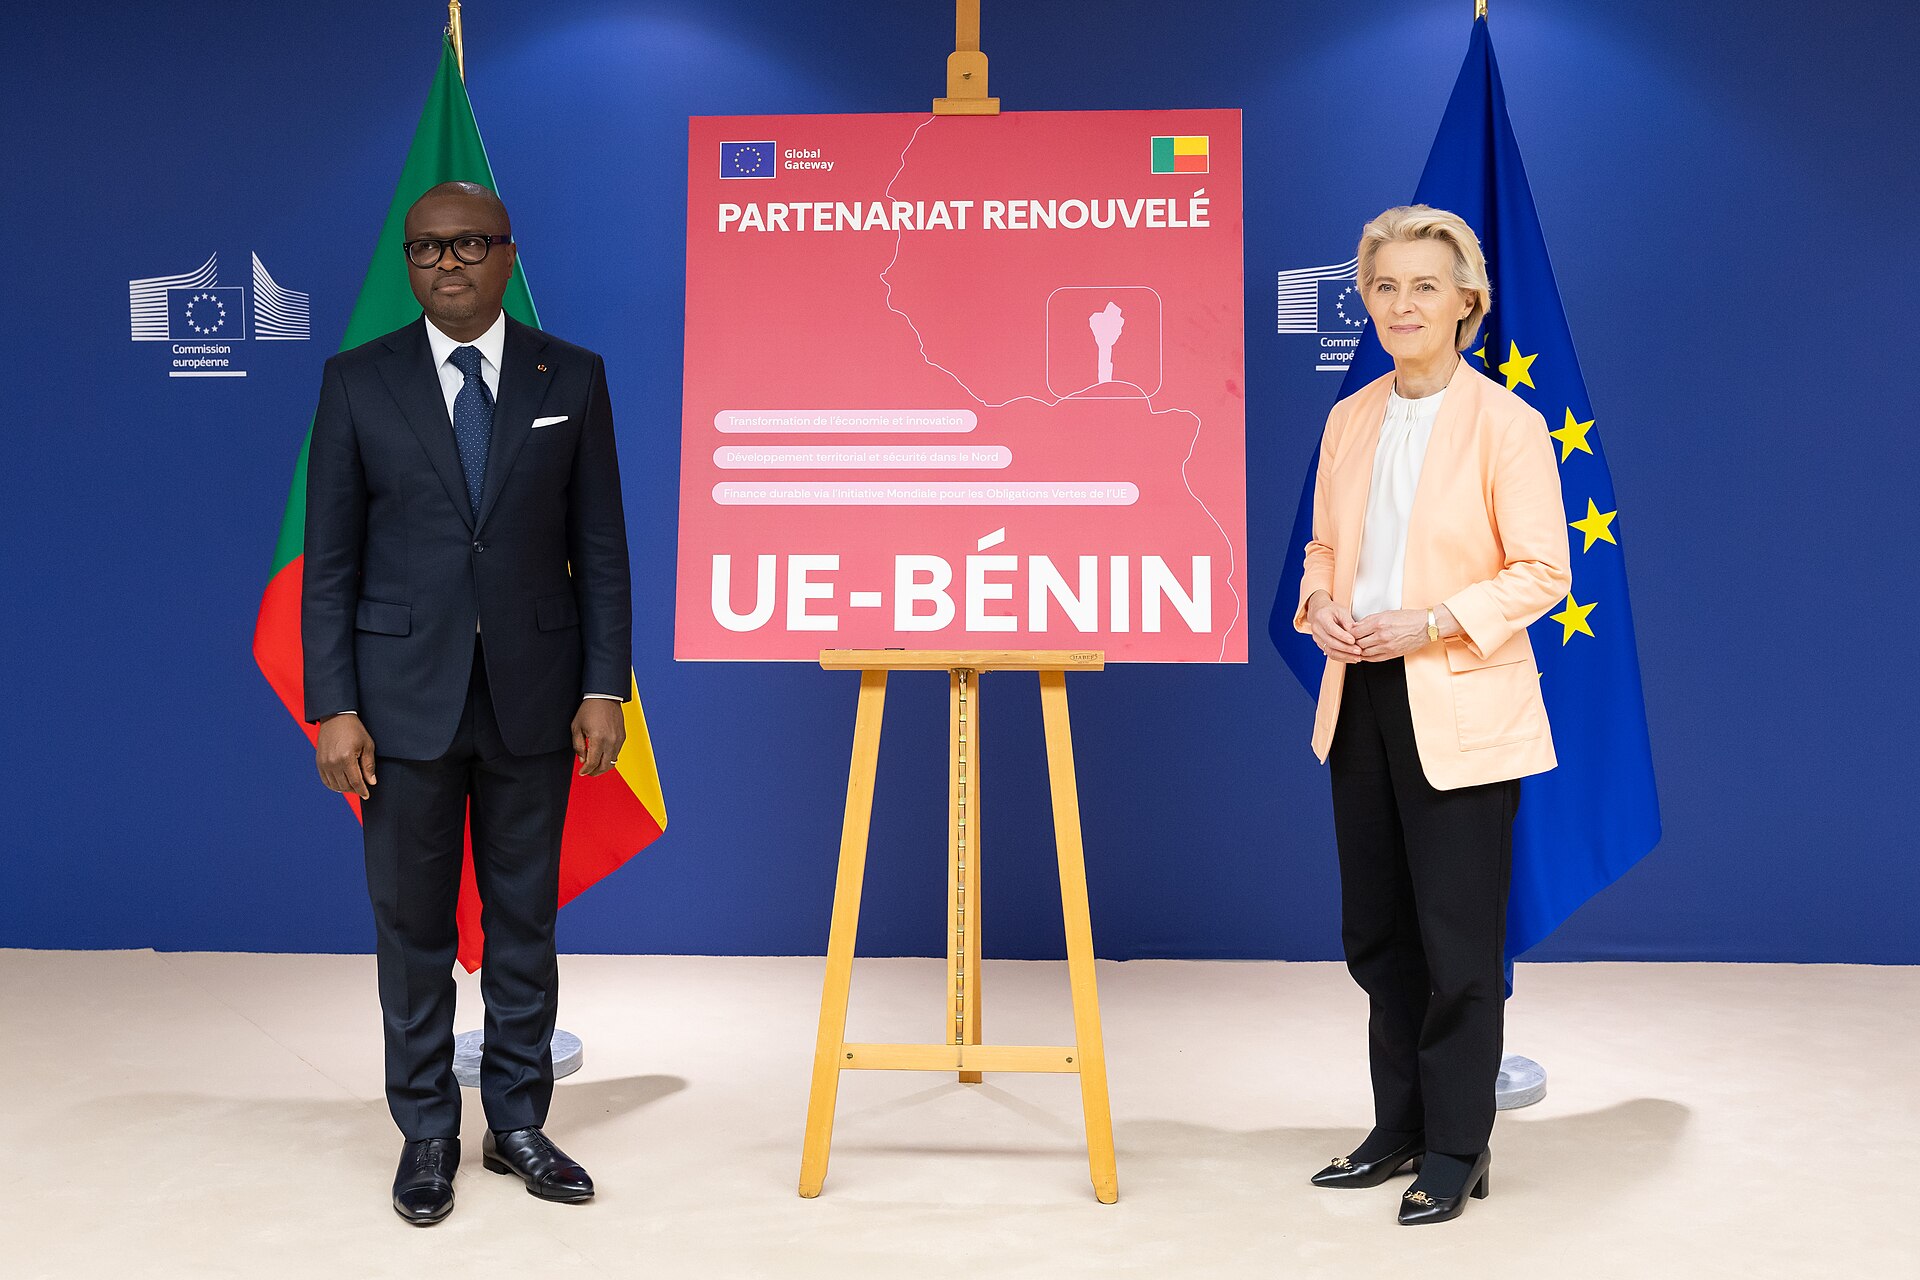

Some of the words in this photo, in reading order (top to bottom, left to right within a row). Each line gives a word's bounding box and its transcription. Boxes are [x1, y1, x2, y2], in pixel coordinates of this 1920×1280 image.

[784, 148, 821, 158] Global
[784, 160, 835, 172] Gateway
[718, 200, 974, 233] PARTENARIAT
[983, 187, 1210, 230] RENOUVELÉ
[1320, 336, 1360, 347] Commis
[172, 343, 231, 354] Commission
[172, 356, 229, 369] européenne
[1320, 349, 1355, 363] europé
[728, 415, 811, 426] Transformation
[813, 415, 828, 426] de
[892, 416, 904, 426] et
[906, 415, 963, 426] innovation
[727, 452, 814, 465] Développement
[816, 451, 866, 462] territorial
[868, 452, 880, 462] et
[882, 451, 928, 462] sécurité
[929, 452, 957, 462] dans
[959, 452, 969, 462] le
[971, 451, 999, 462] Nord
[723, 488, 767, 499] Finance
[769, 488, 811, 499] durable
[813, 488, 830, 499] via
[887, 488, 937, 499] Mondiale
[939, 490, 966, 501] pour
[968, 488, 983, 499] les
[986, 488, 1049, 501] Obligations
[1051, 488, 1087, 499] Vertes
[1089, 488, 1104, 499] de
[711, 527, 1212, 633] UE-BÉNIN
